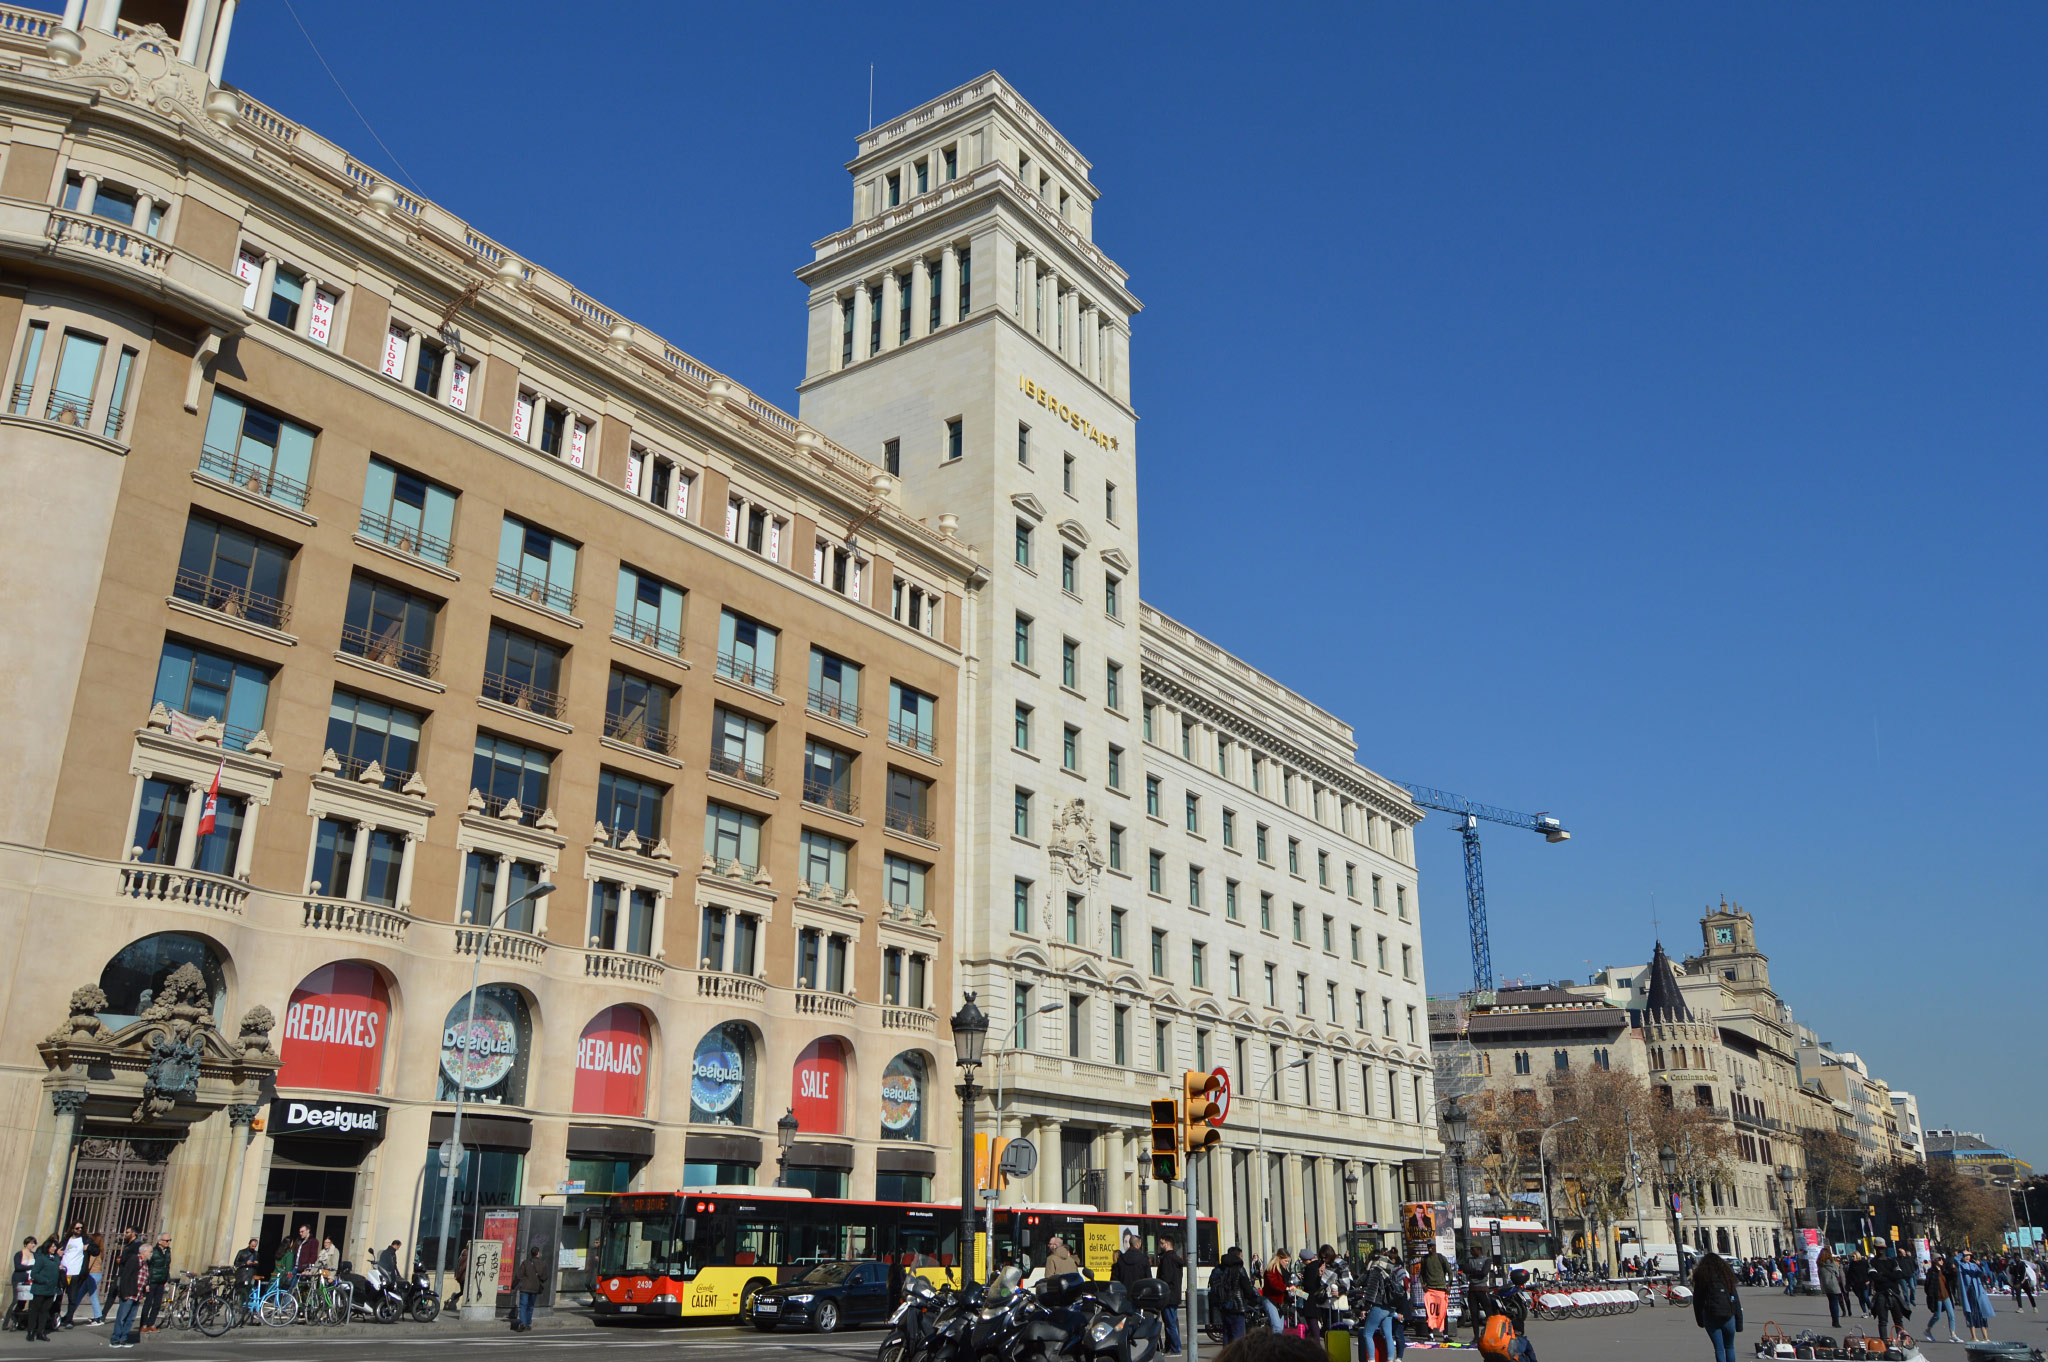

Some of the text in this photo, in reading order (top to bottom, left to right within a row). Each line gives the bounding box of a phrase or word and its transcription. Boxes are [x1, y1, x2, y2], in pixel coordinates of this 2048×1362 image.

[1019, 374, 1109, 452] IBEROSTAR
[285, 1002, 378, 1048] REBAIXES
[442, 1028, 514, 1055] Desigual
[576, 1038, 642, 1076] REBAJAS
[801, 1069, 828, 1099] SALE
[881, 1086, 918, 1102] esigual
[287, 1103, 376, 1132] Desigual
[1089, 1232, 1095, 1241] Jo
[1089, 1243, 1098, 1252] del
[636, 1280, 653, 1289] 2430
[691, 1294, 718, 1308] CALENT
